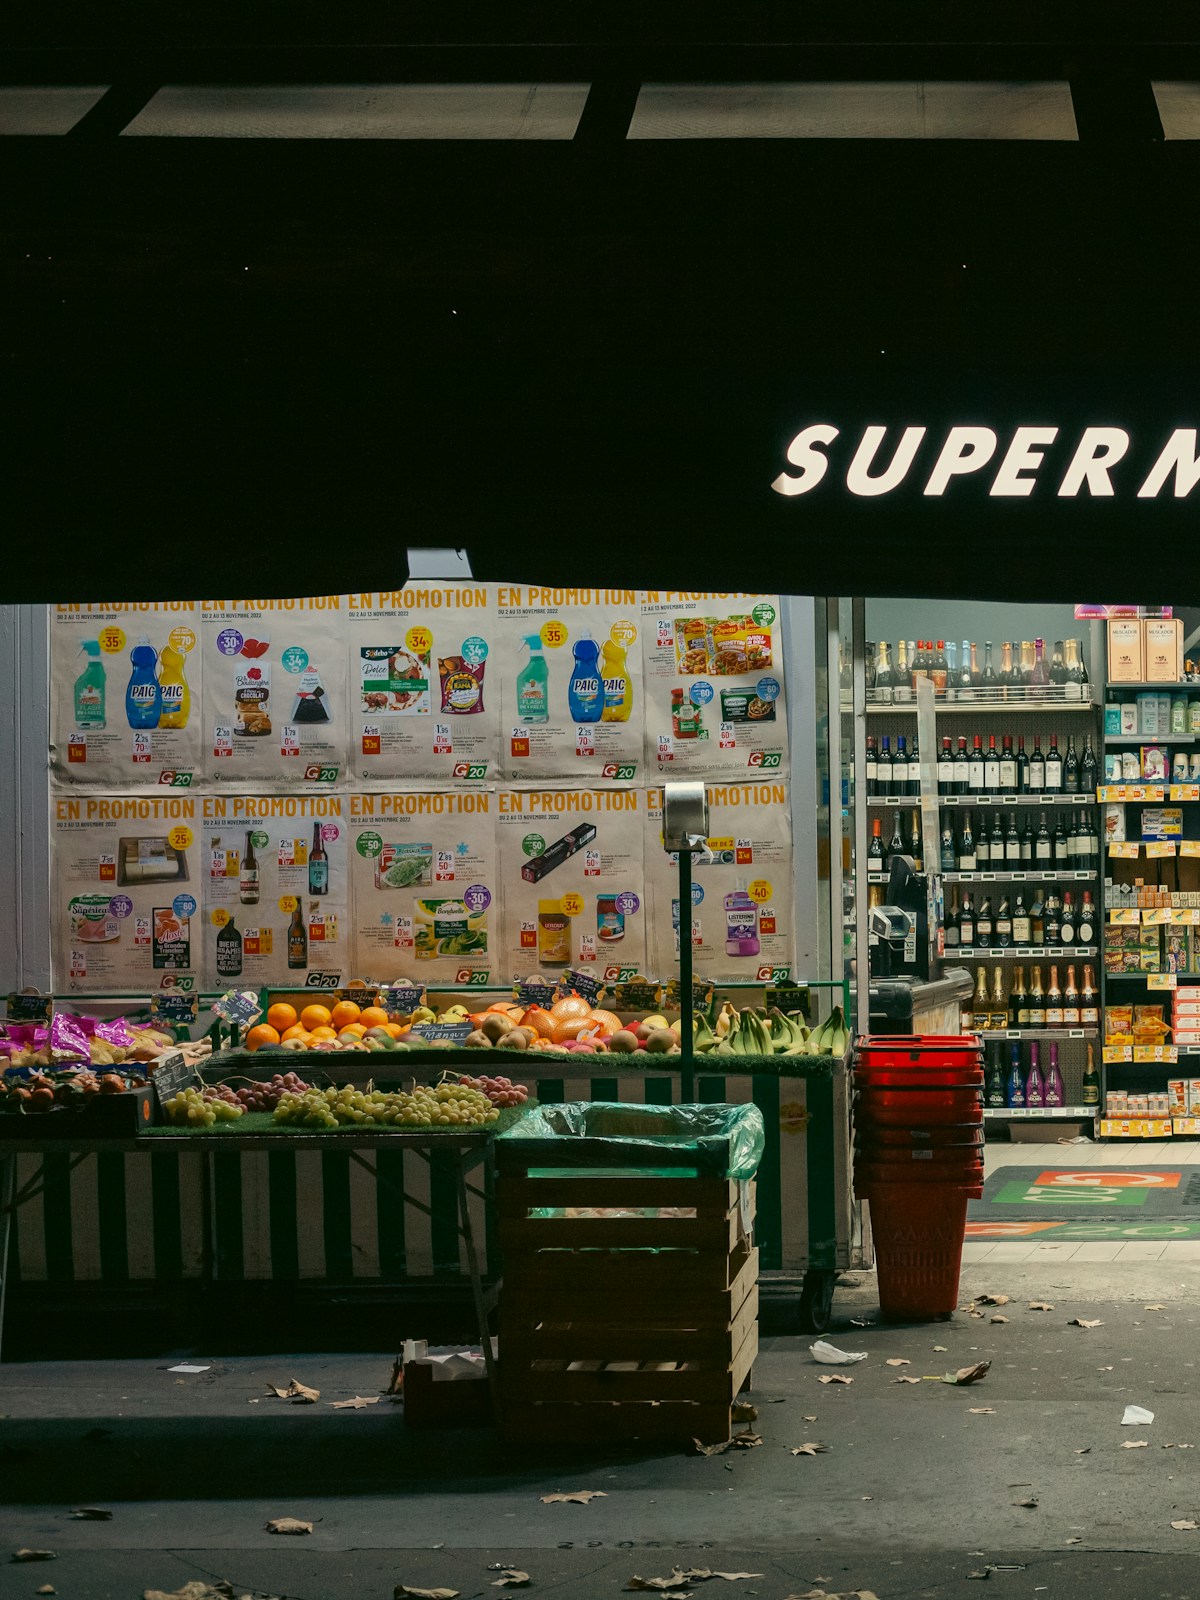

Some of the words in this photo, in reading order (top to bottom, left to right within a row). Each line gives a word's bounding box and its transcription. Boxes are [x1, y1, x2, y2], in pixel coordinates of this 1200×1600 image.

[348, 592, 372, 609] EN
[380, 589, 486, 609] PROMOTION
[498, 588, 520, 606] EN
[529, 588, 636, 606] PROMOTION
[131, 685, 156, 697] PAIC
[574, 679, 599, 691] PAIC
[603, 679, 625, 691] PAIC
[351, 796, 373, 815] EN
[381, 794, 488, 814] PROMOTION
[499, 793, 522, 812] EN
[530, 791, 637, 811] PROMOTION
[708, 785, 785, 807] MOTION
[56, 800, 80, 820] EN
[87, 799, 195, 819] PROMOTION
[203, 799, 226, 817] EN
[234, 797, 341, 817] PROMOTION
[424, 1031, 466, 1040] Mangue
